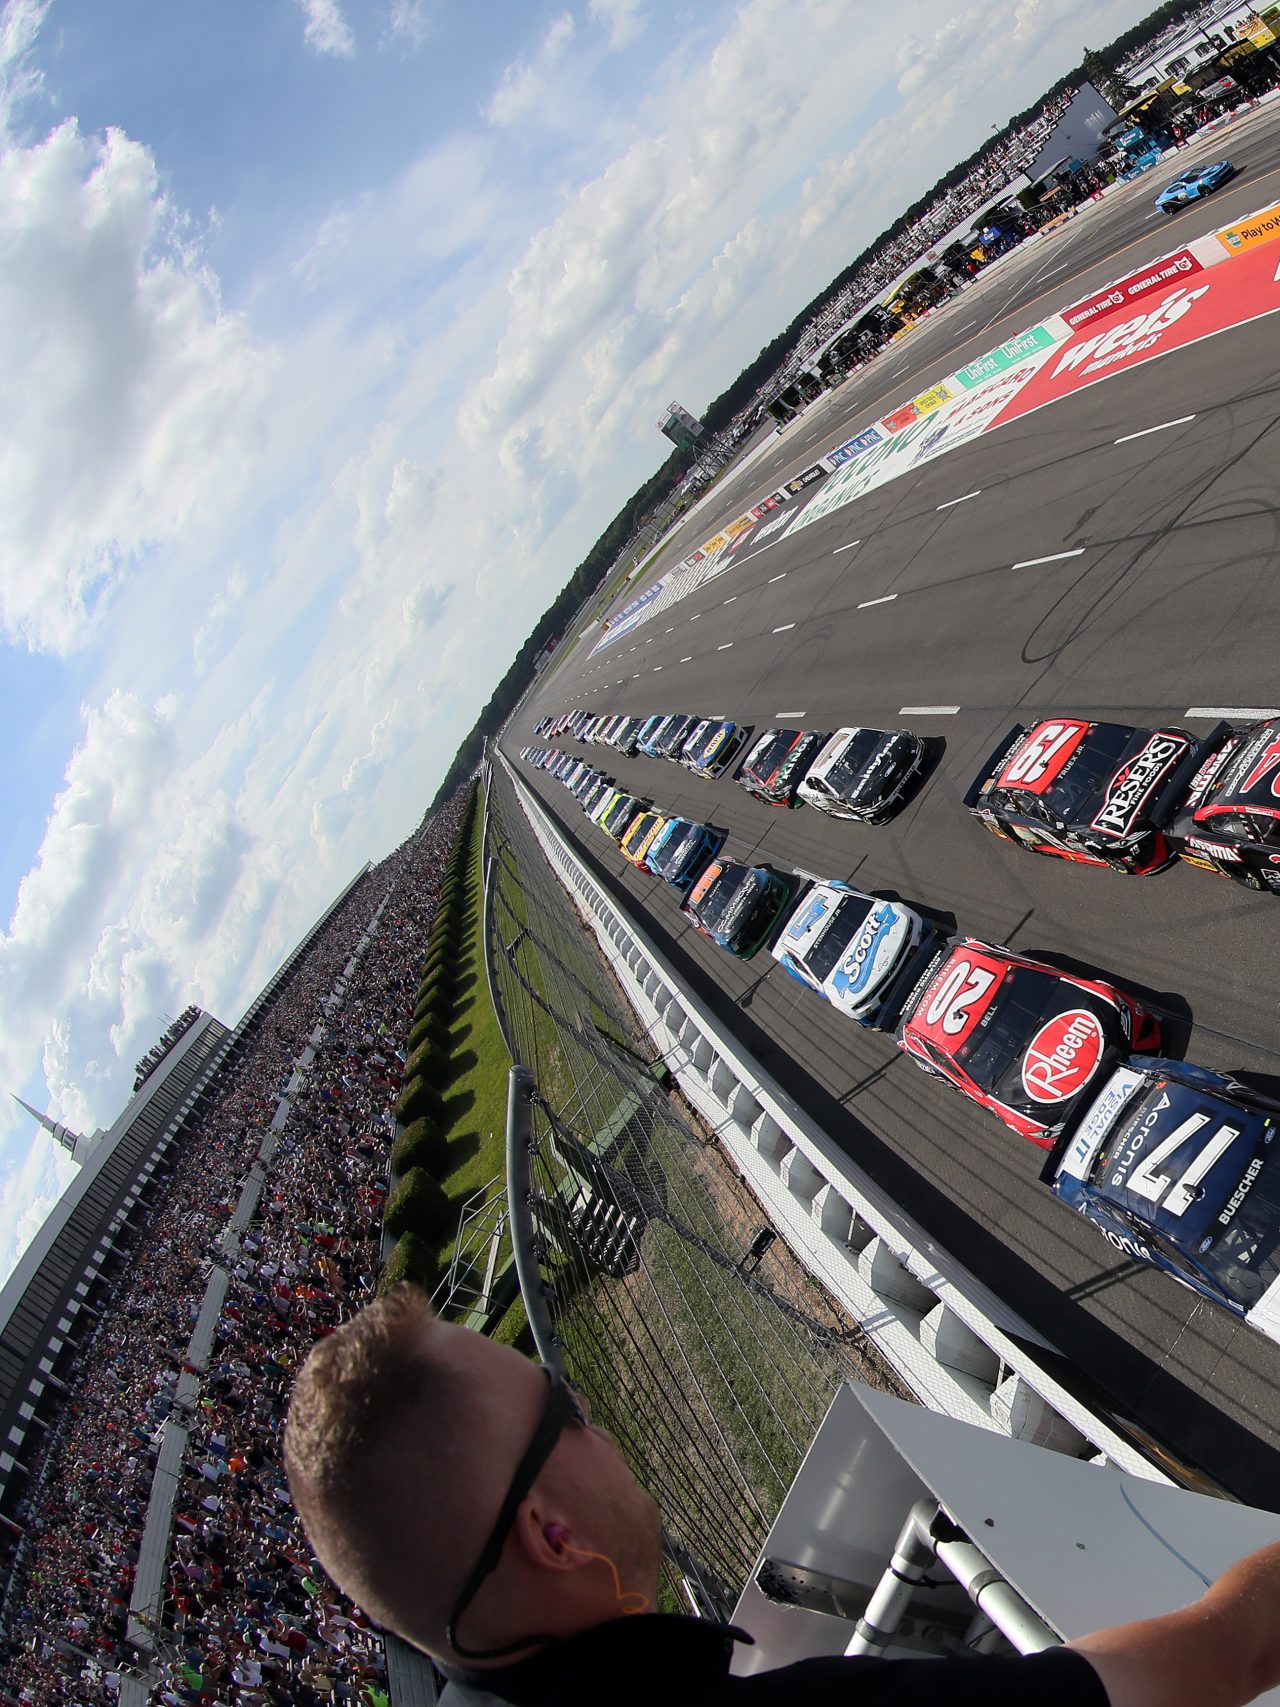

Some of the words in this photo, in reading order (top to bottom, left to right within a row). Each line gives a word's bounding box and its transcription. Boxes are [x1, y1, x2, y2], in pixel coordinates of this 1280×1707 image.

[1241, 227, 1263, 240] Play
[1262, 222, 1274, 232] to
[1128, 274, 1163, 295] GENERAL
[1159, 265, 1179, 280] TIRE
[1069, 307, 1099, 325] GENERAL
[1096, 299, 1113, 311] TIRE
[965, 357, 999, 380] UniFirst
[1002, 334, 1038, 359] UniFirst
[821, 410, 940, 494] POCONO
[851, 734, 900, 799] Smithfield
[1005, 723, 1083, 785] 19
[1057, 754, 1078, 780] TRUEX
[1102, 739, 1177, 829] RESER'S
[1130, 786, 1143, 806] FINE
[1142, 762, 1163, 788] FOODS
[813, 915, 837, 949] STENHOUSE
[844, 913, 880, 984] Scott
[917, 958, 957, 1016] RHEEM.COM
[926, 960, 997, 1036] 20
[980, 1005, 998, 1028] BELL
[1025, 1016, 1096, 1098] Rheem
[1086, 1091, 1116, 1137] EDGE
[1093, 1083, 1134, 1139] VISUAL
[1074, 1138, 1091, 1164] IT
[1111, 1092, 1171, 1187] Acronis
[1125, 1112, 1240, 1217] 17
[1219, 1158, 1264, 1225] BUESCHER
